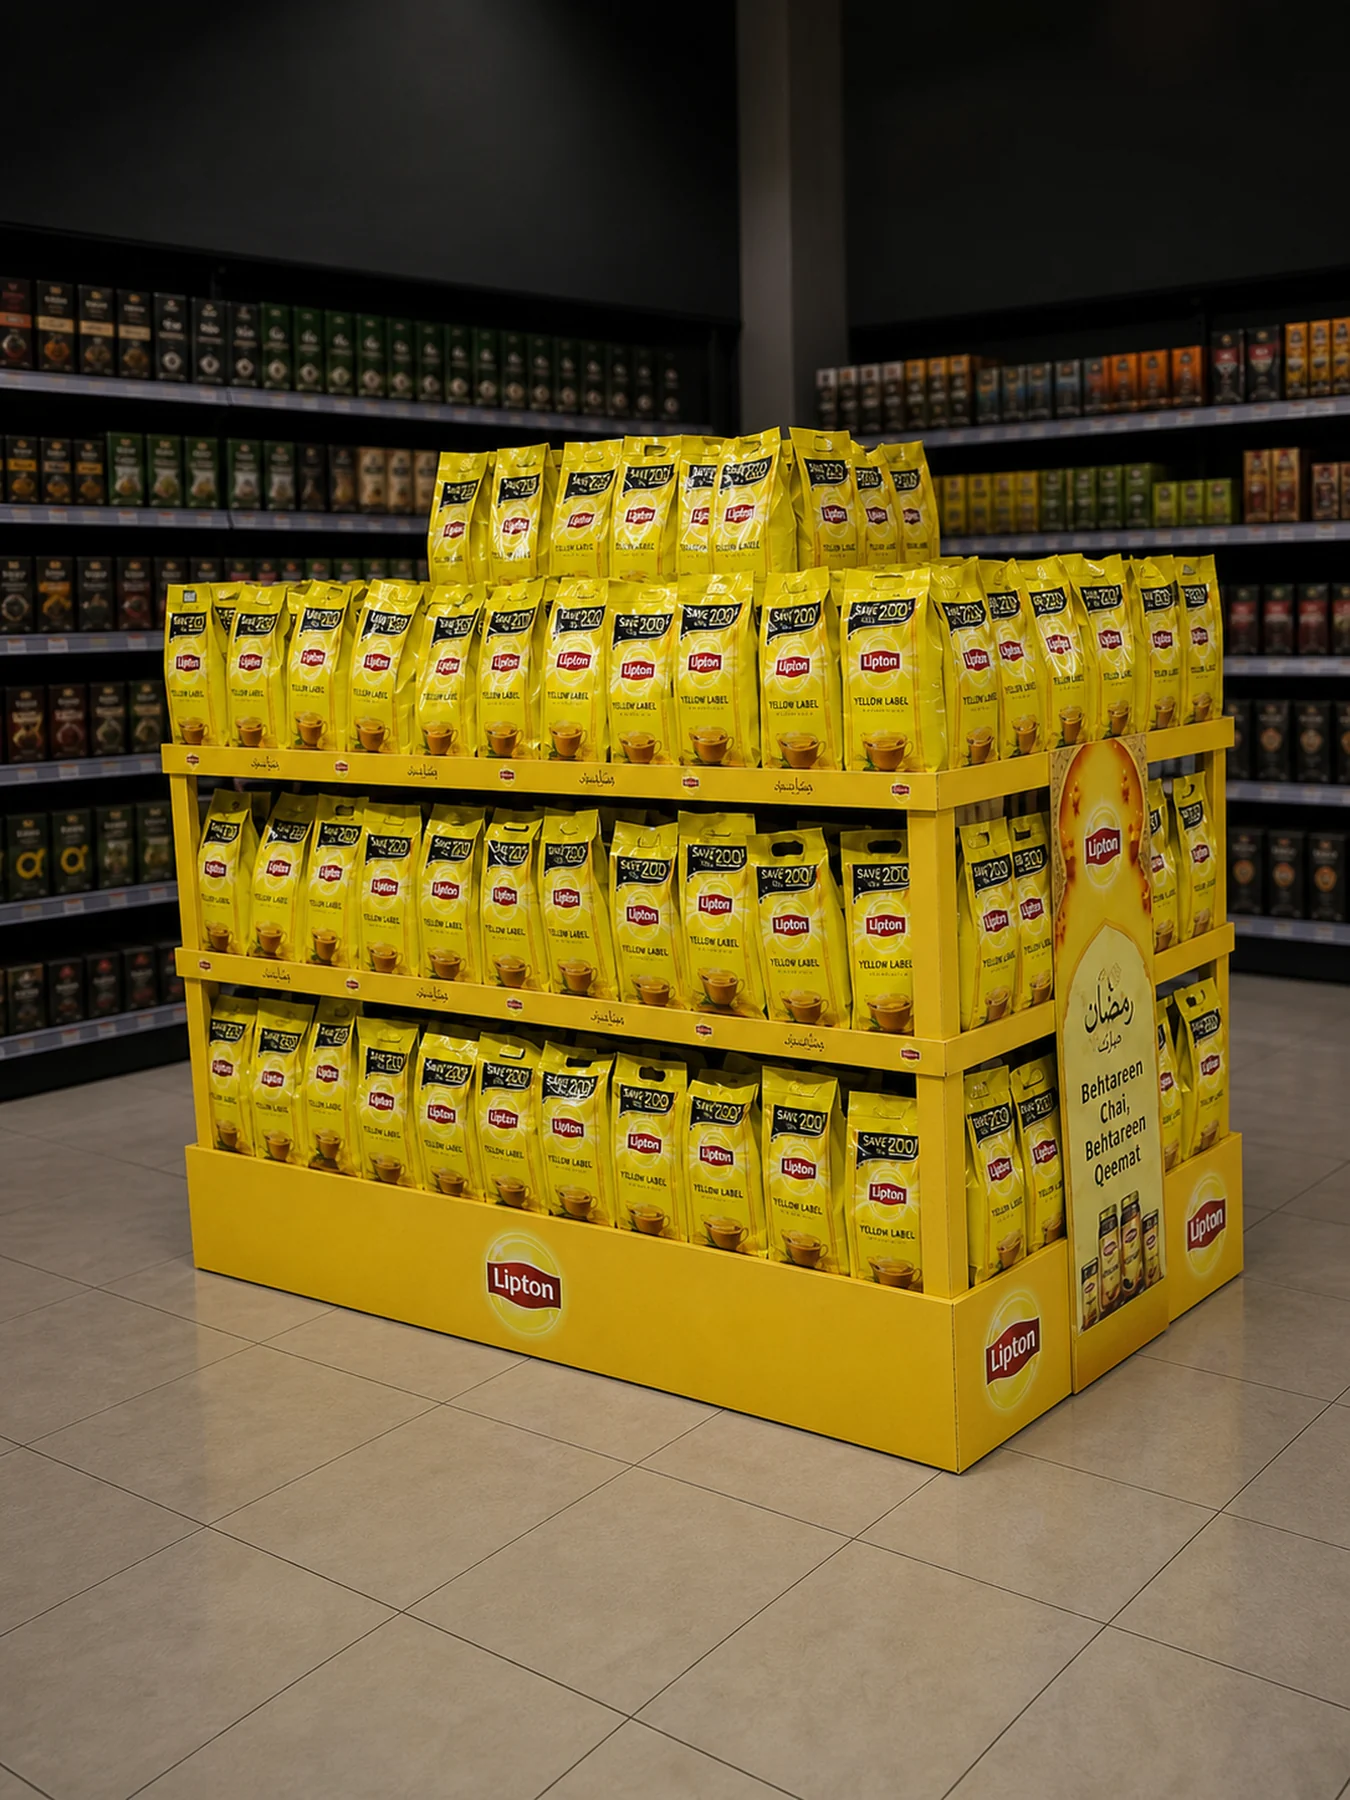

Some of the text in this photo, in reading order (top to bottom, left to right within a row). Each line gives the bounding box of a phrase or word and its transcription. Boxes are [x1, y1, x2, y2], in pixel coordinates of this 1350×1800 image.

[691, 657, 719, 670] Lipton
[779, 660, 808, 674] Lipton
[864, 656, 896, 668] Lipton
[624, 665, 652, 677] Lipton
[707, 696, 728, 704] LABEL
[796, 700, 819, 708] LABEL
[885, 697, 908, 705] LABEL
[1089, 837, 1119, 857] Lipton
[857, 868, 880, 879] SAVE
[701, 897, 730, 912] Lipton
[629, 909, 657, 922] Lipton
[775, 919, 807, 934] Lipton
[869, 919, 903, 934] Lipton
[717, 938, 739, 948] LABEL
[798, 959, 820, 968] LABEL
[890, 960, 912, 968] LABEL
[1085, 978, 1134, 1034] رمضان
[1081, 1062, 1144, 1104] Behtareen
[1100, 1094, 1130, 1123] Chai,
[630, 1136, 660, 1150] Lipton
[863, 1135, 887, 1147] SAVE
[1085, 1117, 1146, 1162] Behtareen
[702, 1148, 731, 1163] Lipton
[783, 1161, 814, 1176] Lipton
[1094, 1145, 1141, 1187] Qeemat
[721, 1189, 743, 1198] LABEL
[872, 1186, 904, 1201] Lipton
[801, 1205, 822, 1215] LABEL
[1190, 1208, 1223, 1240] Lipton
[860, 1225, 915, 1239] YELLOW LABEL
[494, 1267, 554, 1301] Lipton
[990, 1330, 1035, 1372] Lipton
